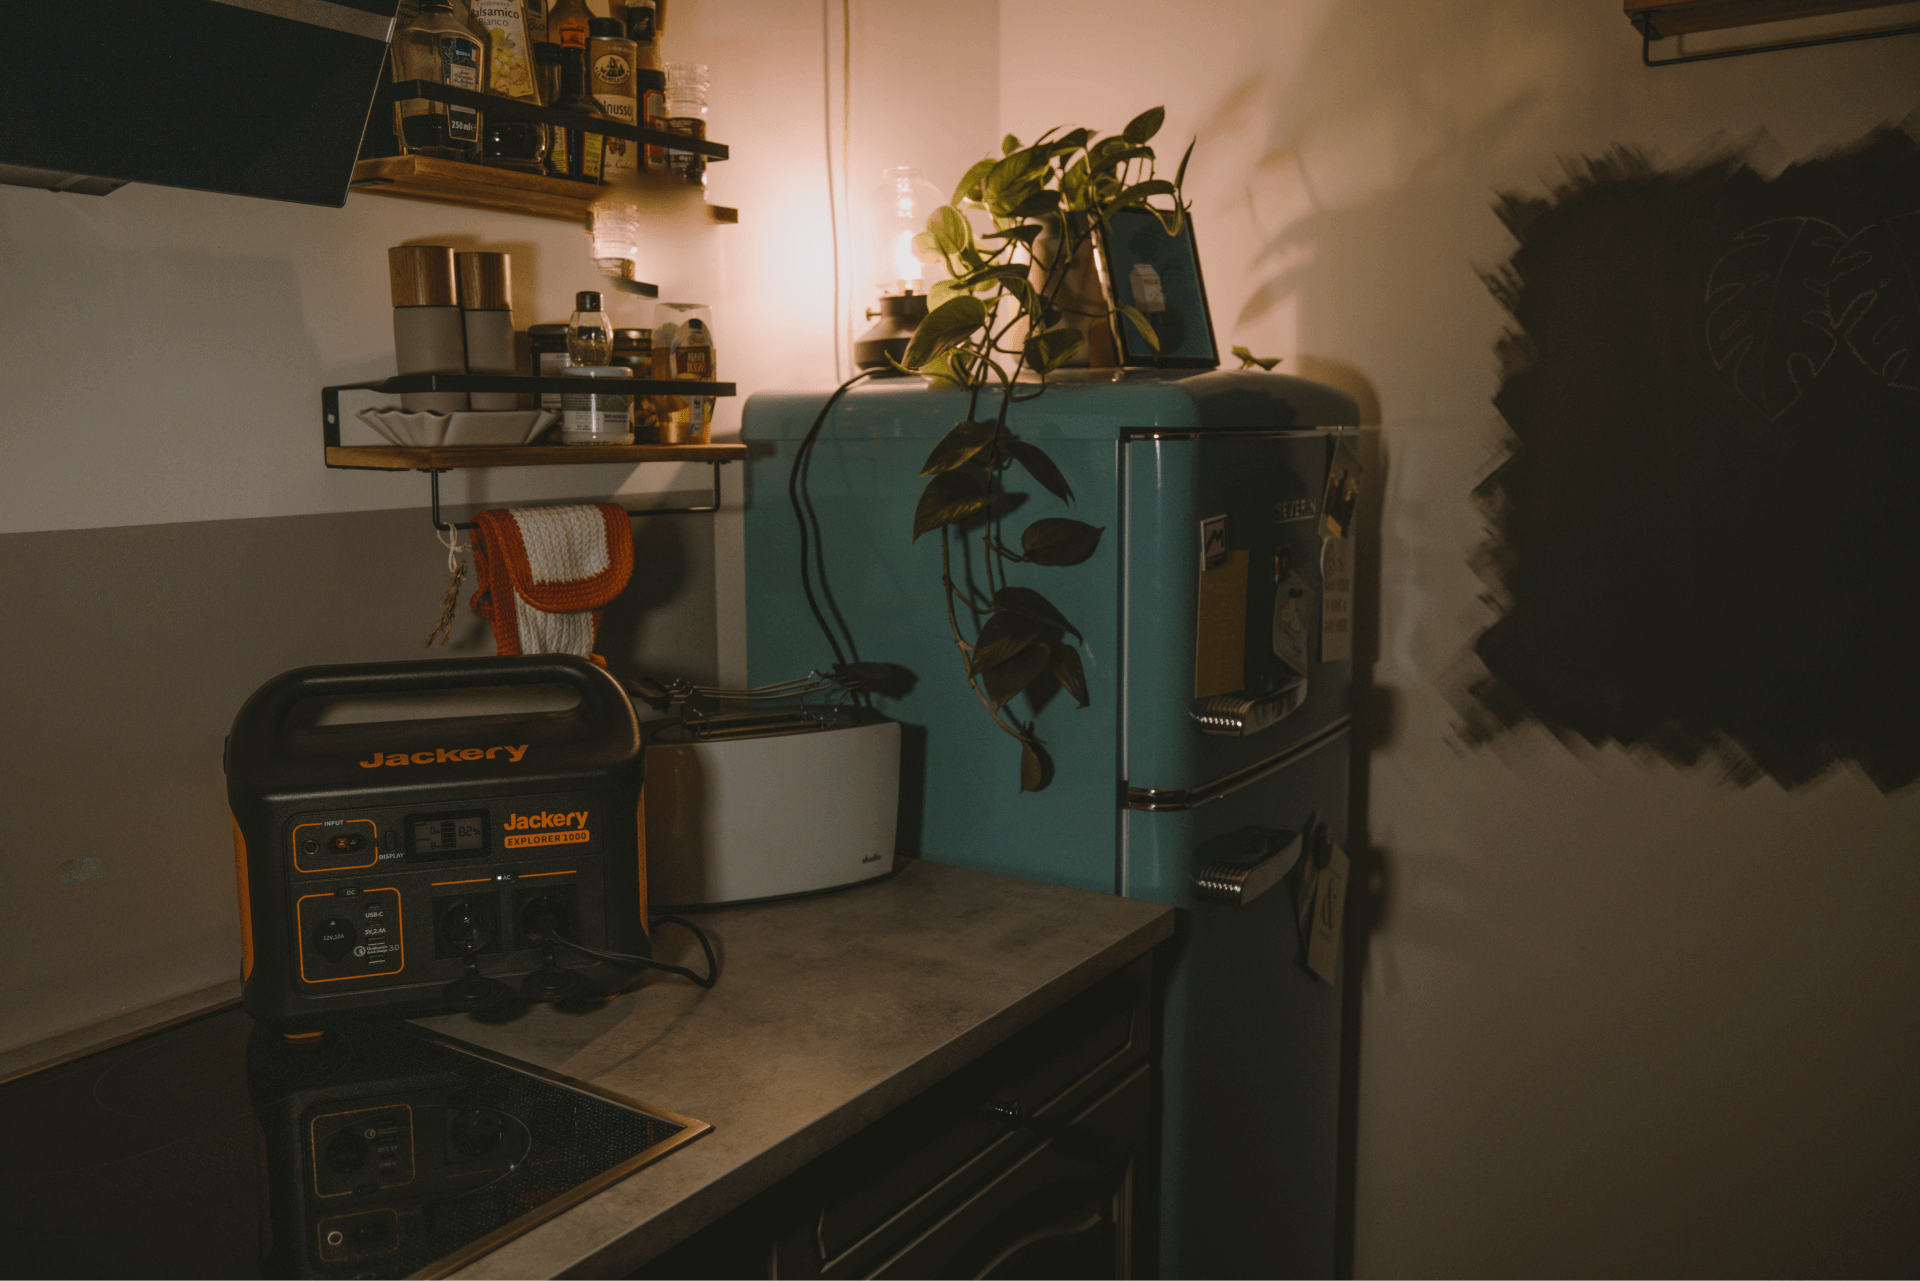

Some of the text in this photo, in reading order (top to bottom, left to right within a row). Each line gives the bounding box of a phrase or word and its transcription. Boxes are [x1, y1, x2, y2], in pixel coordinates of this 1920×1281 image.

[471, 7, 520, 19] Balsamico
[478, 17, 509, 27] Bianco
[1275, 499, 1316, 520] SEVERIN
[359, 744, 529, 769] Jackery
[324, 819, 344, 827] INPUT
[503, 811, 589, 831] Jackery
[507, 832, 587, 846] EXPLORER 1000
[378, 852, 405, 860] DISPLAY
